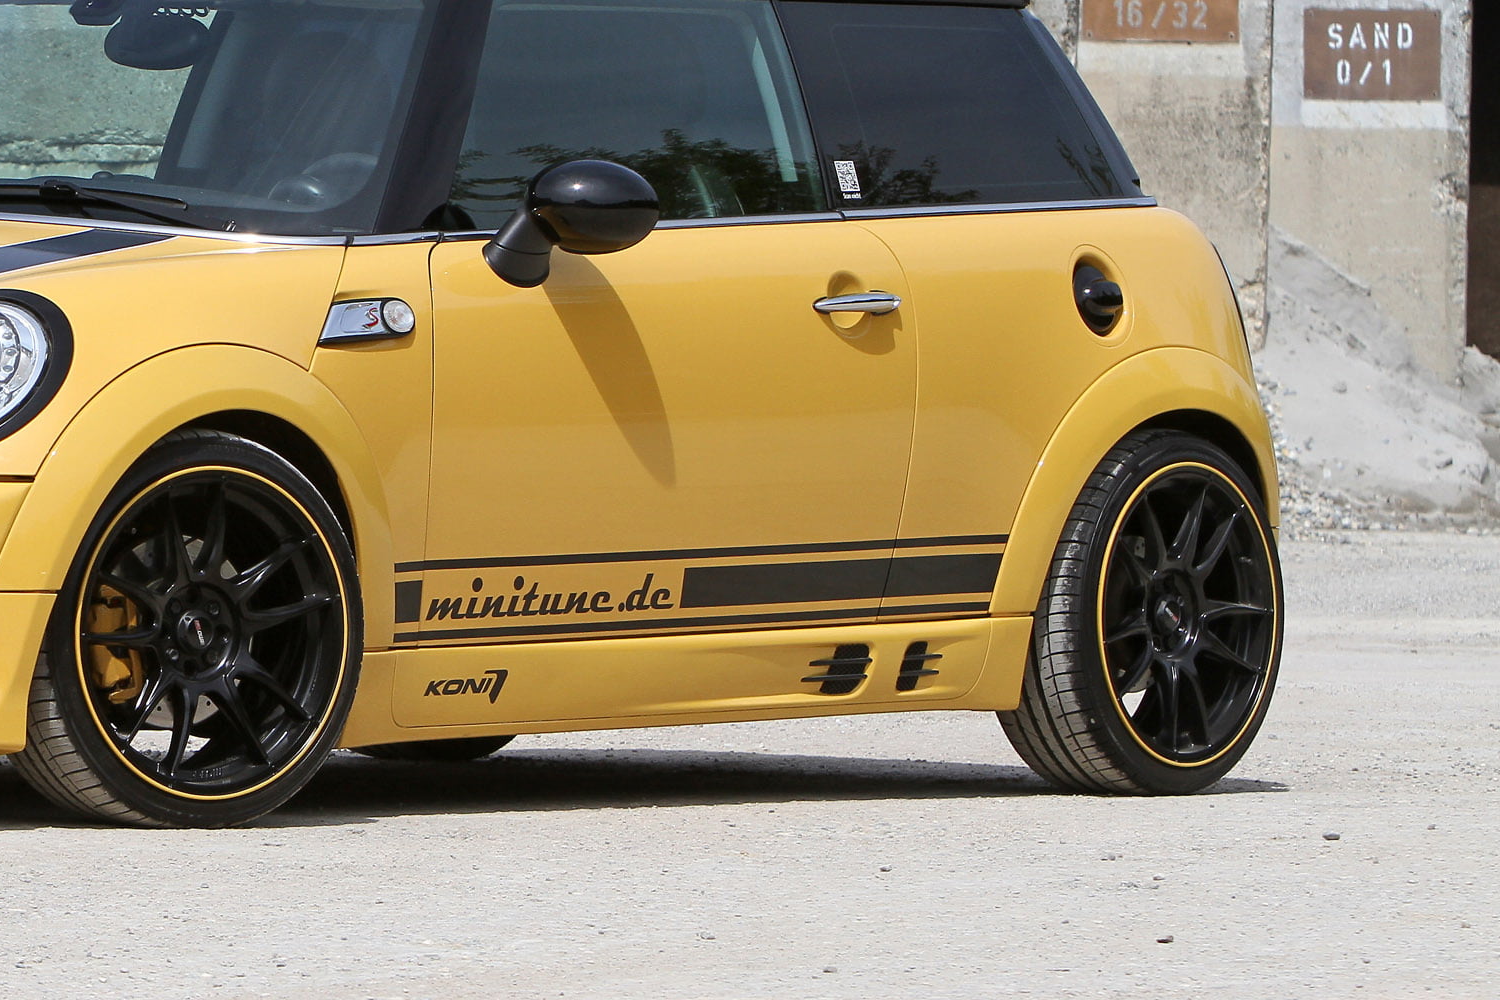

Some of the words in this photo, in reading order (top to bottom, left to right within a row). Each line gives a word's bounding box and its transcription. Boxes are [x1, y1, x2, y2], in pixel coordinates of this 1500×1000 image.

[1327, 22, 1414, 50] SAND
[1336, 58, 1392, 86] 0/1
[425, 572, 674, 621] minitune.de
